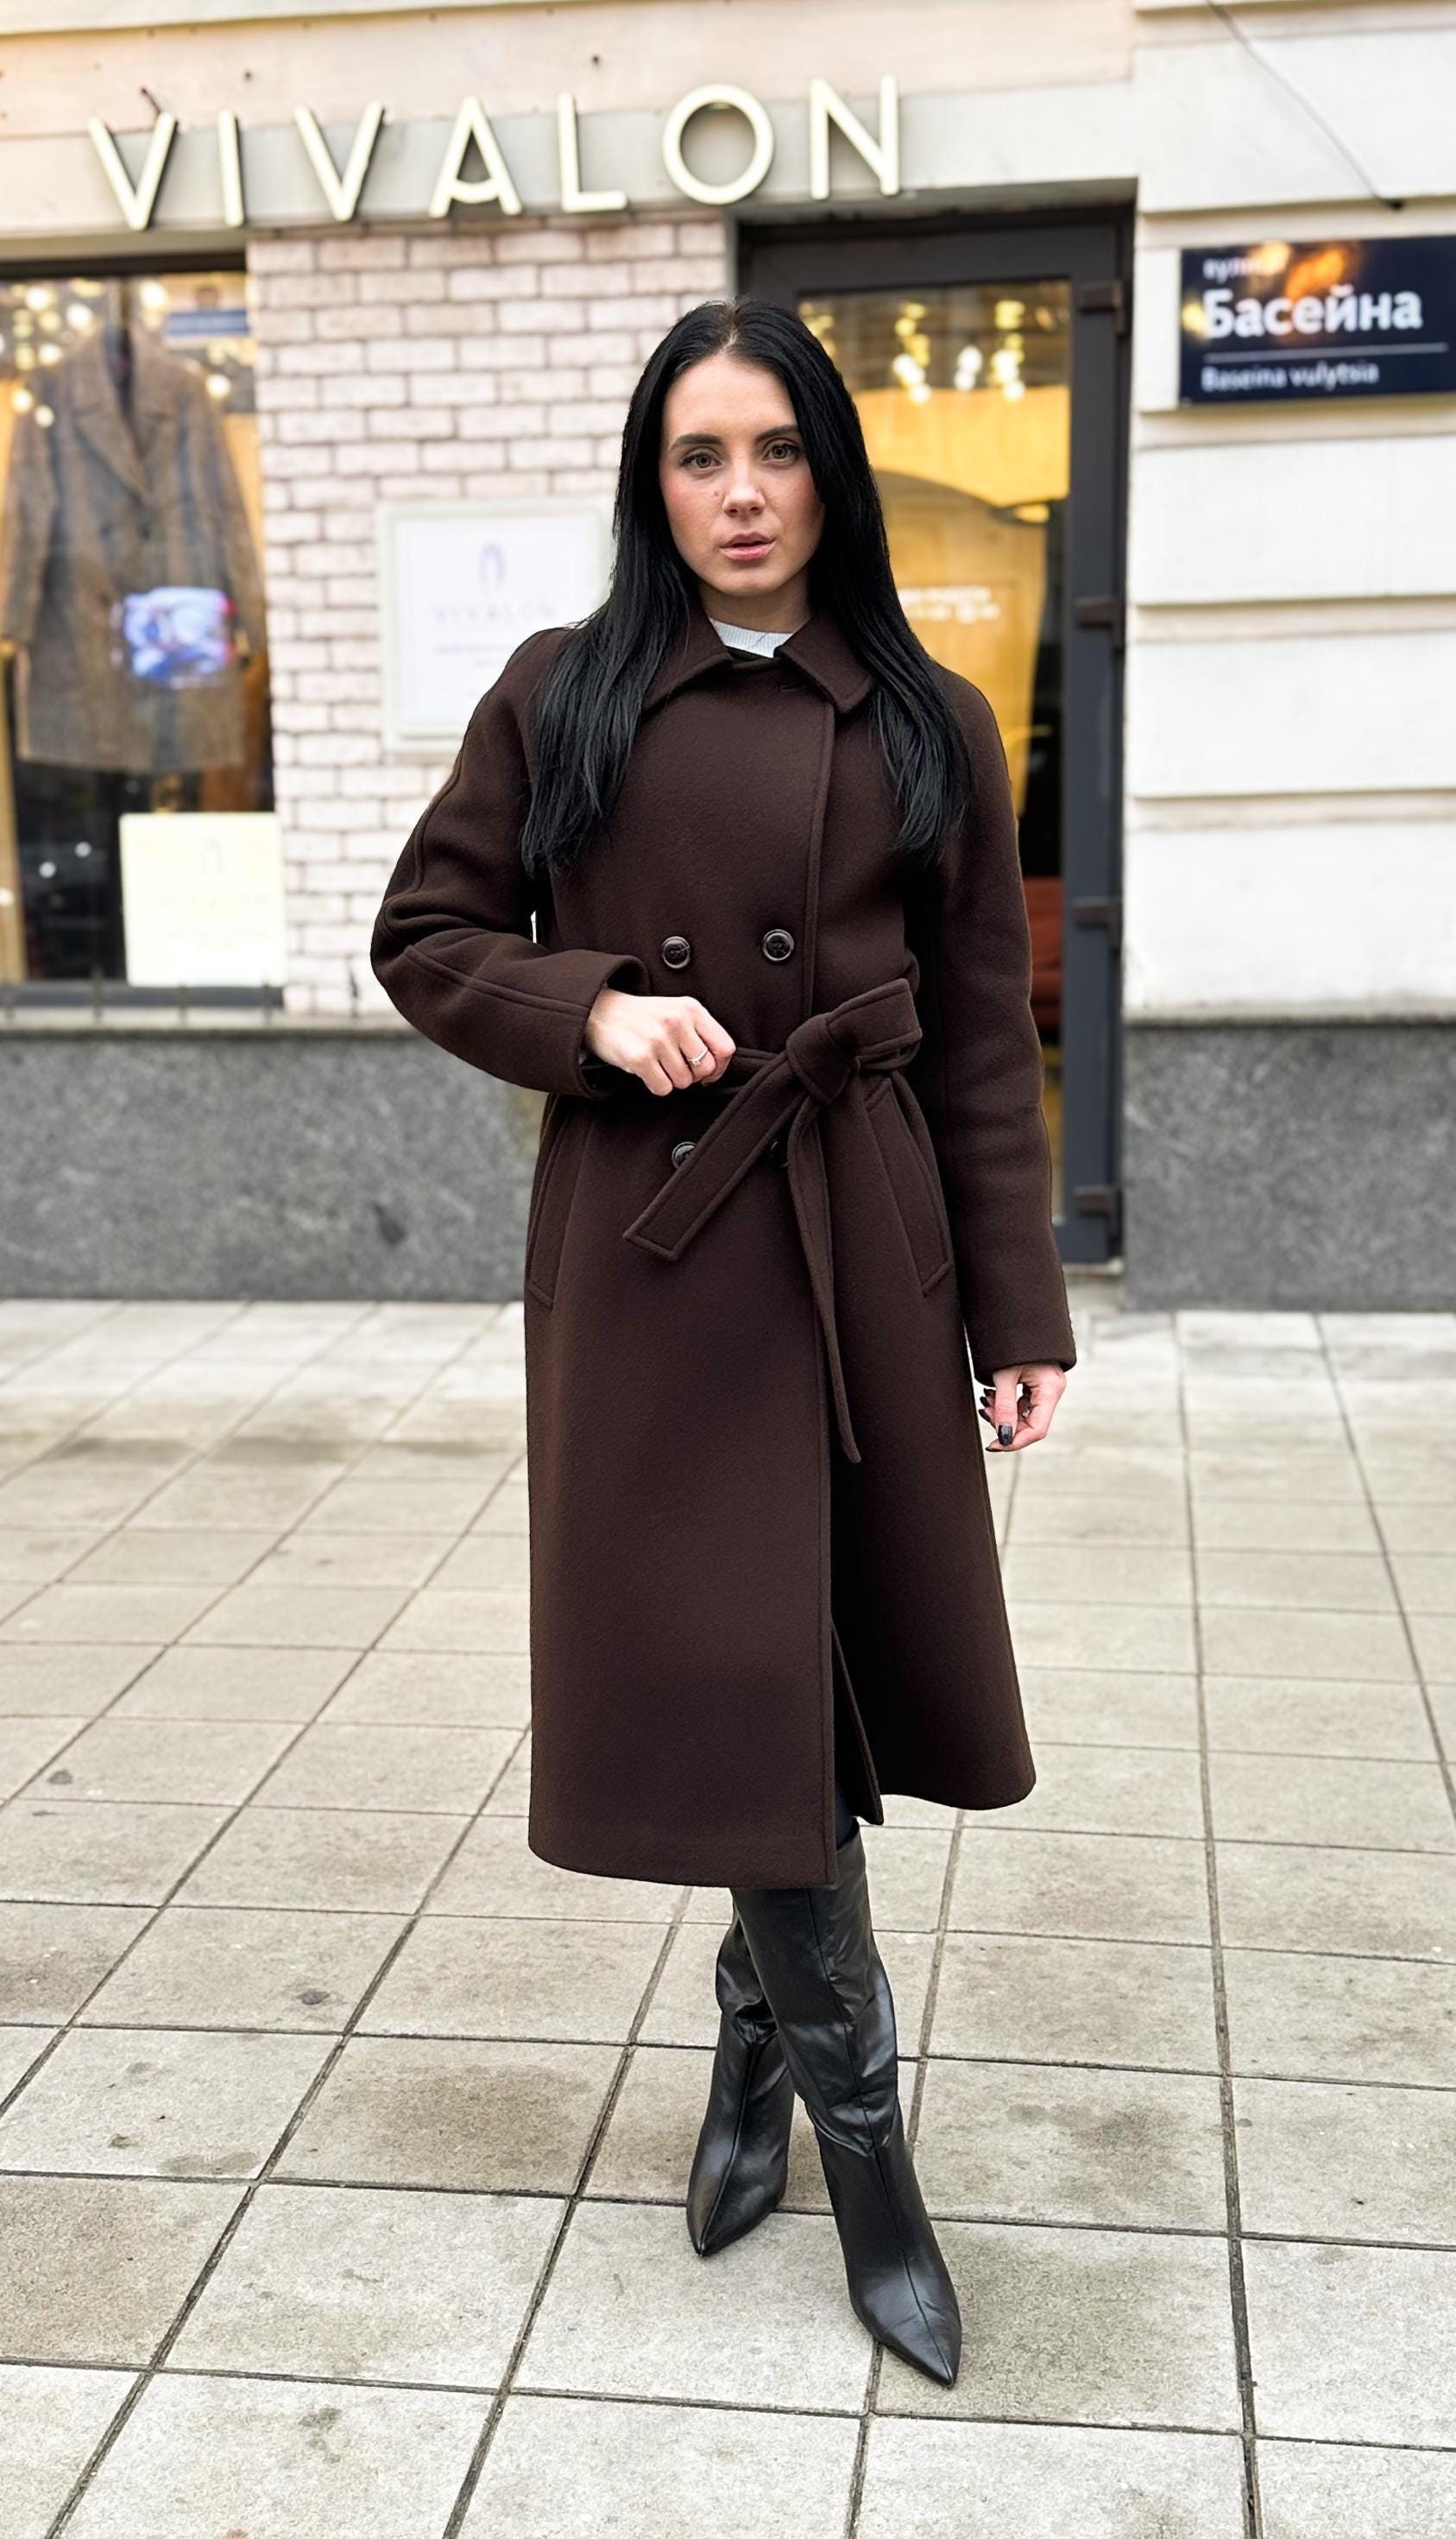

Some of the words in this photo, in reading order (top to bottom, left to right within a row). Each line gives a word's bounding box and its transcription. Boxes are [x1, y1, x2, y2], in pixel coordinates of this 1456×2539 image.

[87, 75, 900, 231] VIVALON
[1202, 284, 1423, 338] Басейна
[1201, 364, 1286, 391] Baseina
[1288, 361, 1380, 390] vulytsia
